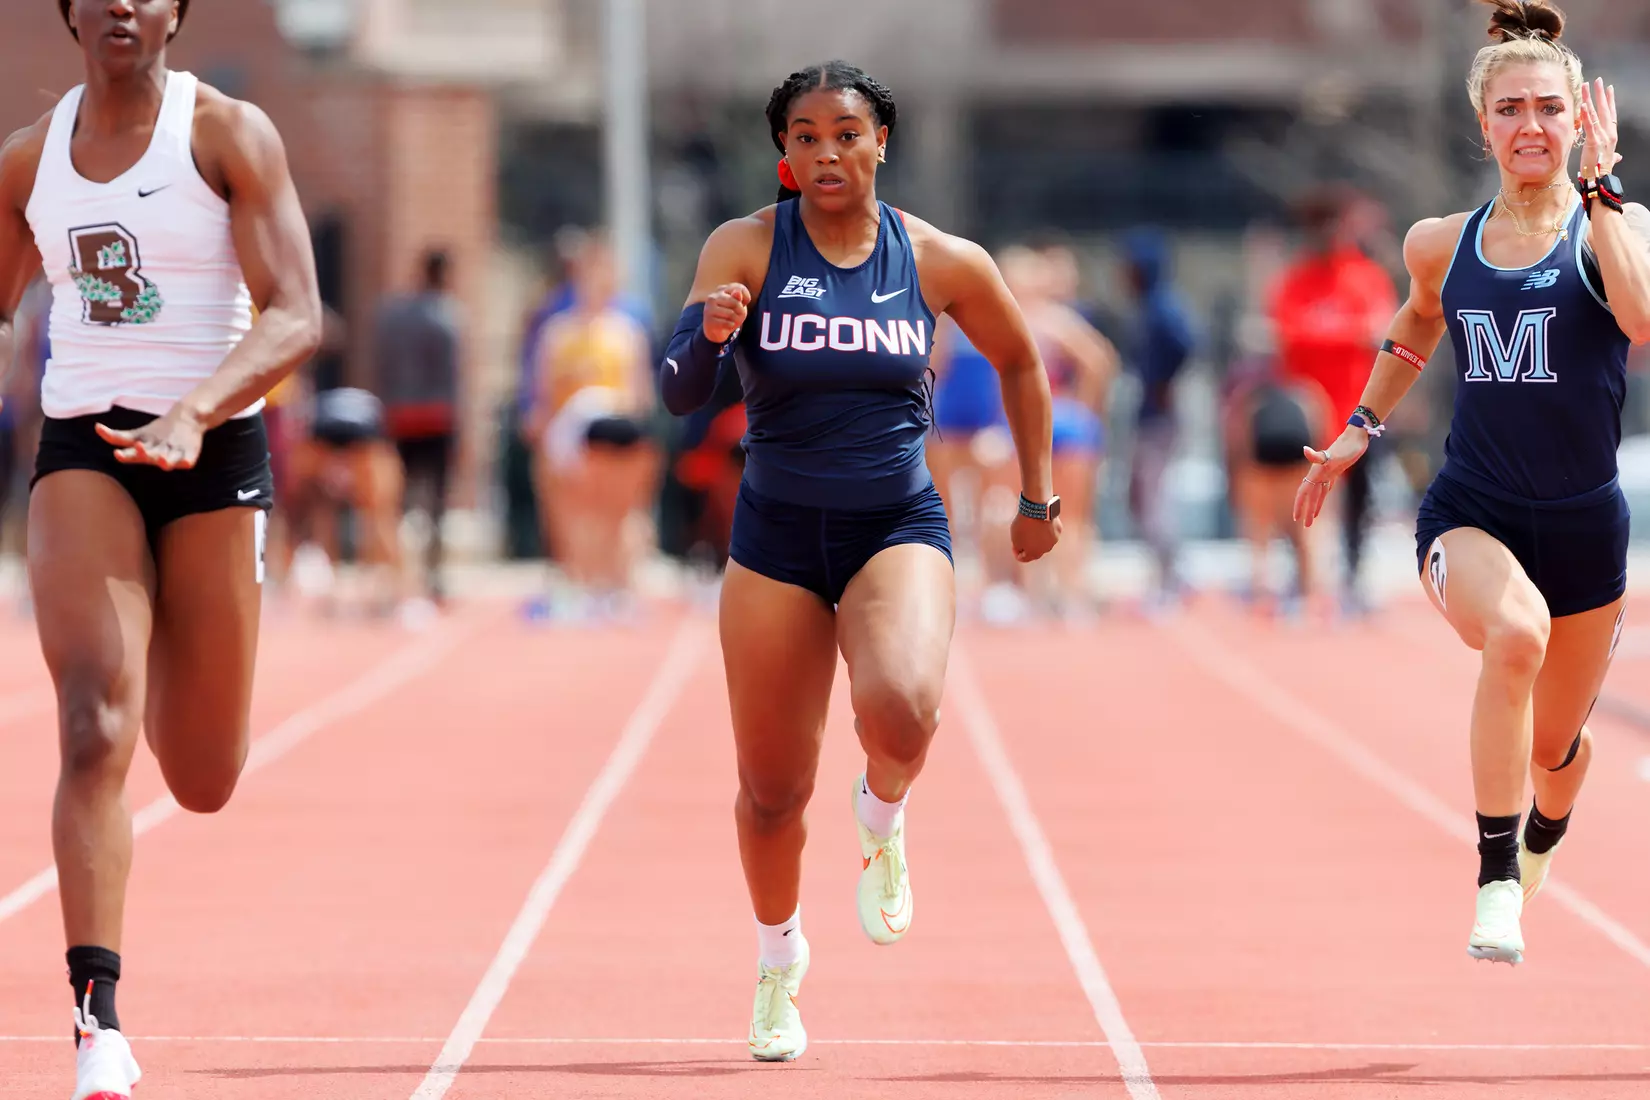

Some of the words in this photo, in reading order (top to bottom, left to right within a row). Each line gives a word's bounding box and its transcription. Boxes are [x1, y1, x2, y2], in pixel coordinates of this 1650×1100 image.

[780, 286, 827, 298] EAST
[786, 275, 820, 288] BIG
[759, 311, 926, 356] UCONN
[1457, 306, 1558, 383] M
